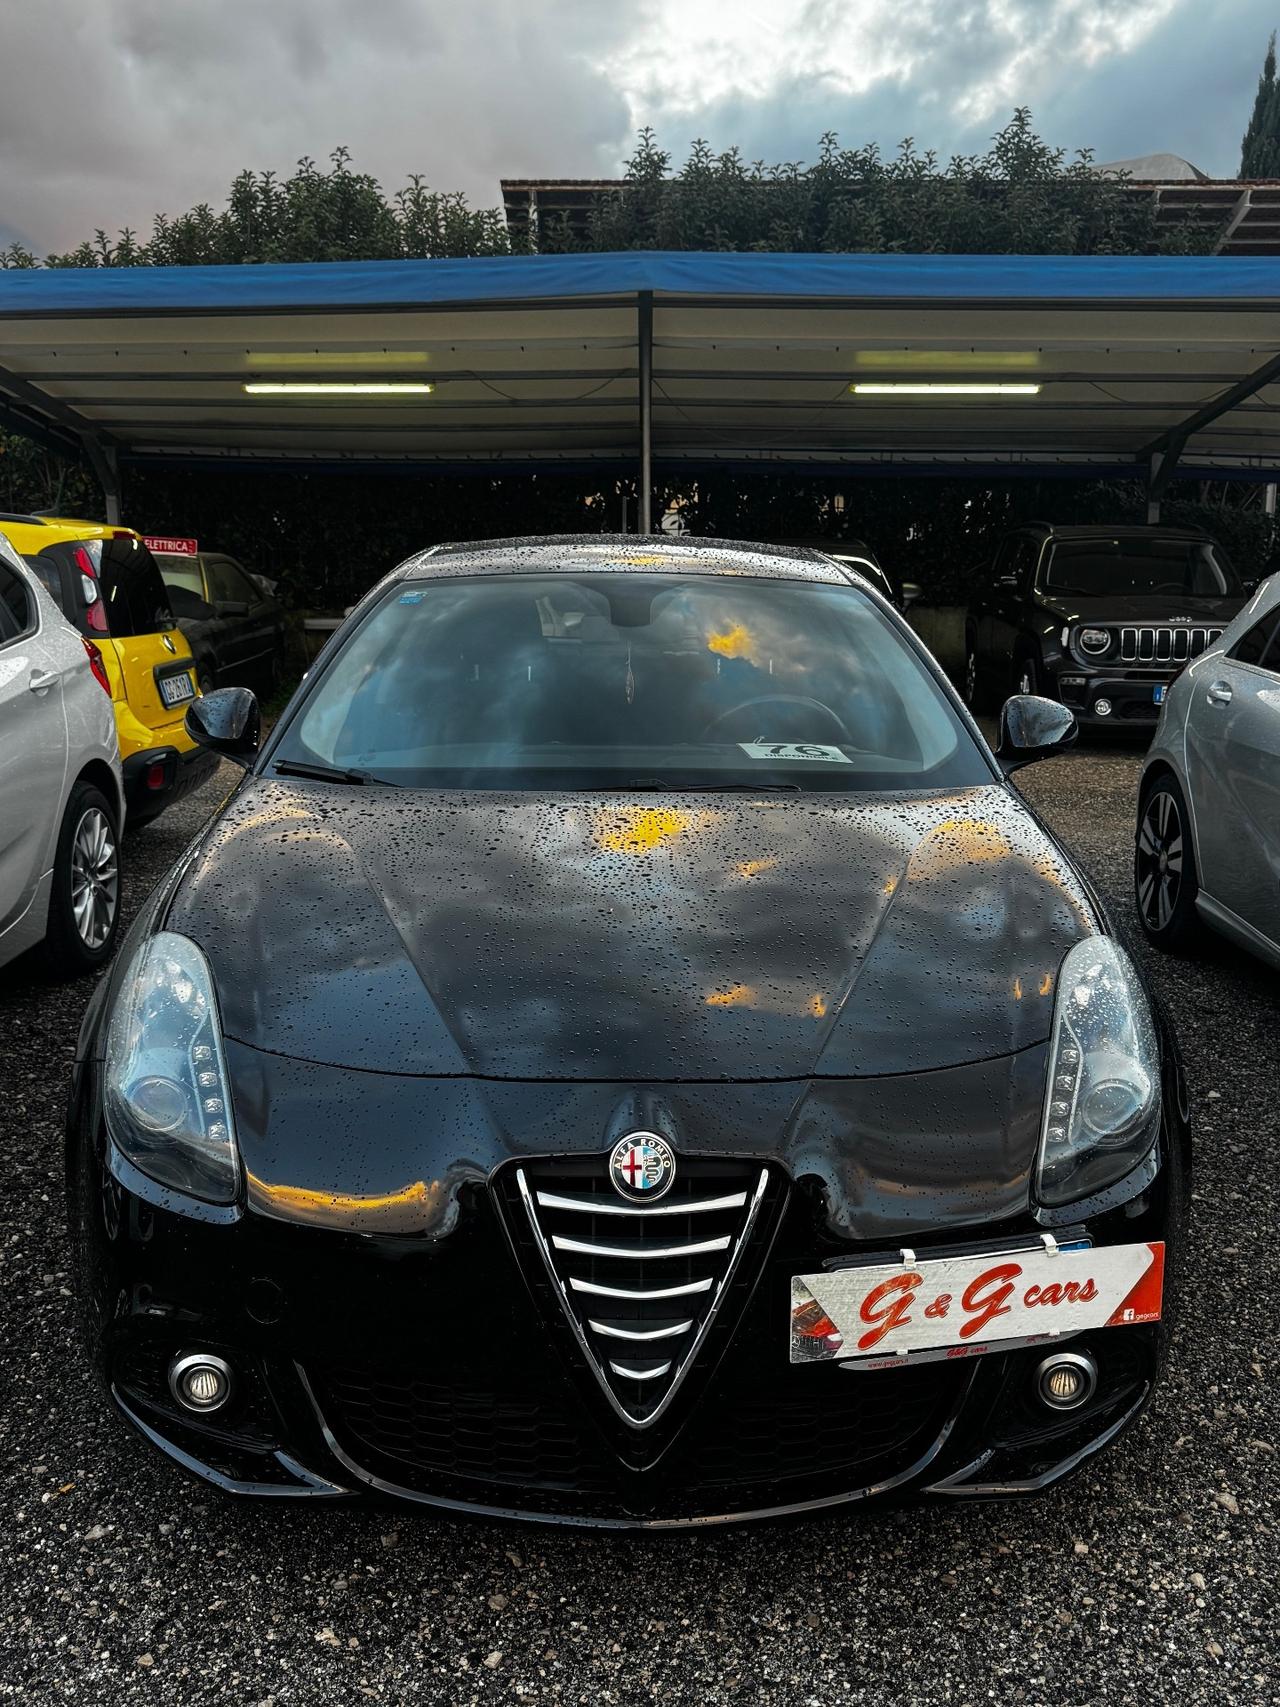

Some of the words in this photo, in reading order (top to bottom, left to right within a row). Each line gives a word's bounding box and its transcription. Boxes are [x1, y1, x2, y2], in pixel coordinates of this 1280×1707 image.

[144, 540, 188, 552] ELETTRICA
[757, 745, 830, 757] 76
[614, 1142, 635, 1169] ALFA
[640, 1138, 671, 1168] ROMEO
[858, 1272, 923, 1351] G
[924, 1293, 952, 1319] &
[959, 1263, 1022, 1339] G
[1023, 1278, 1099, 1308] cars
